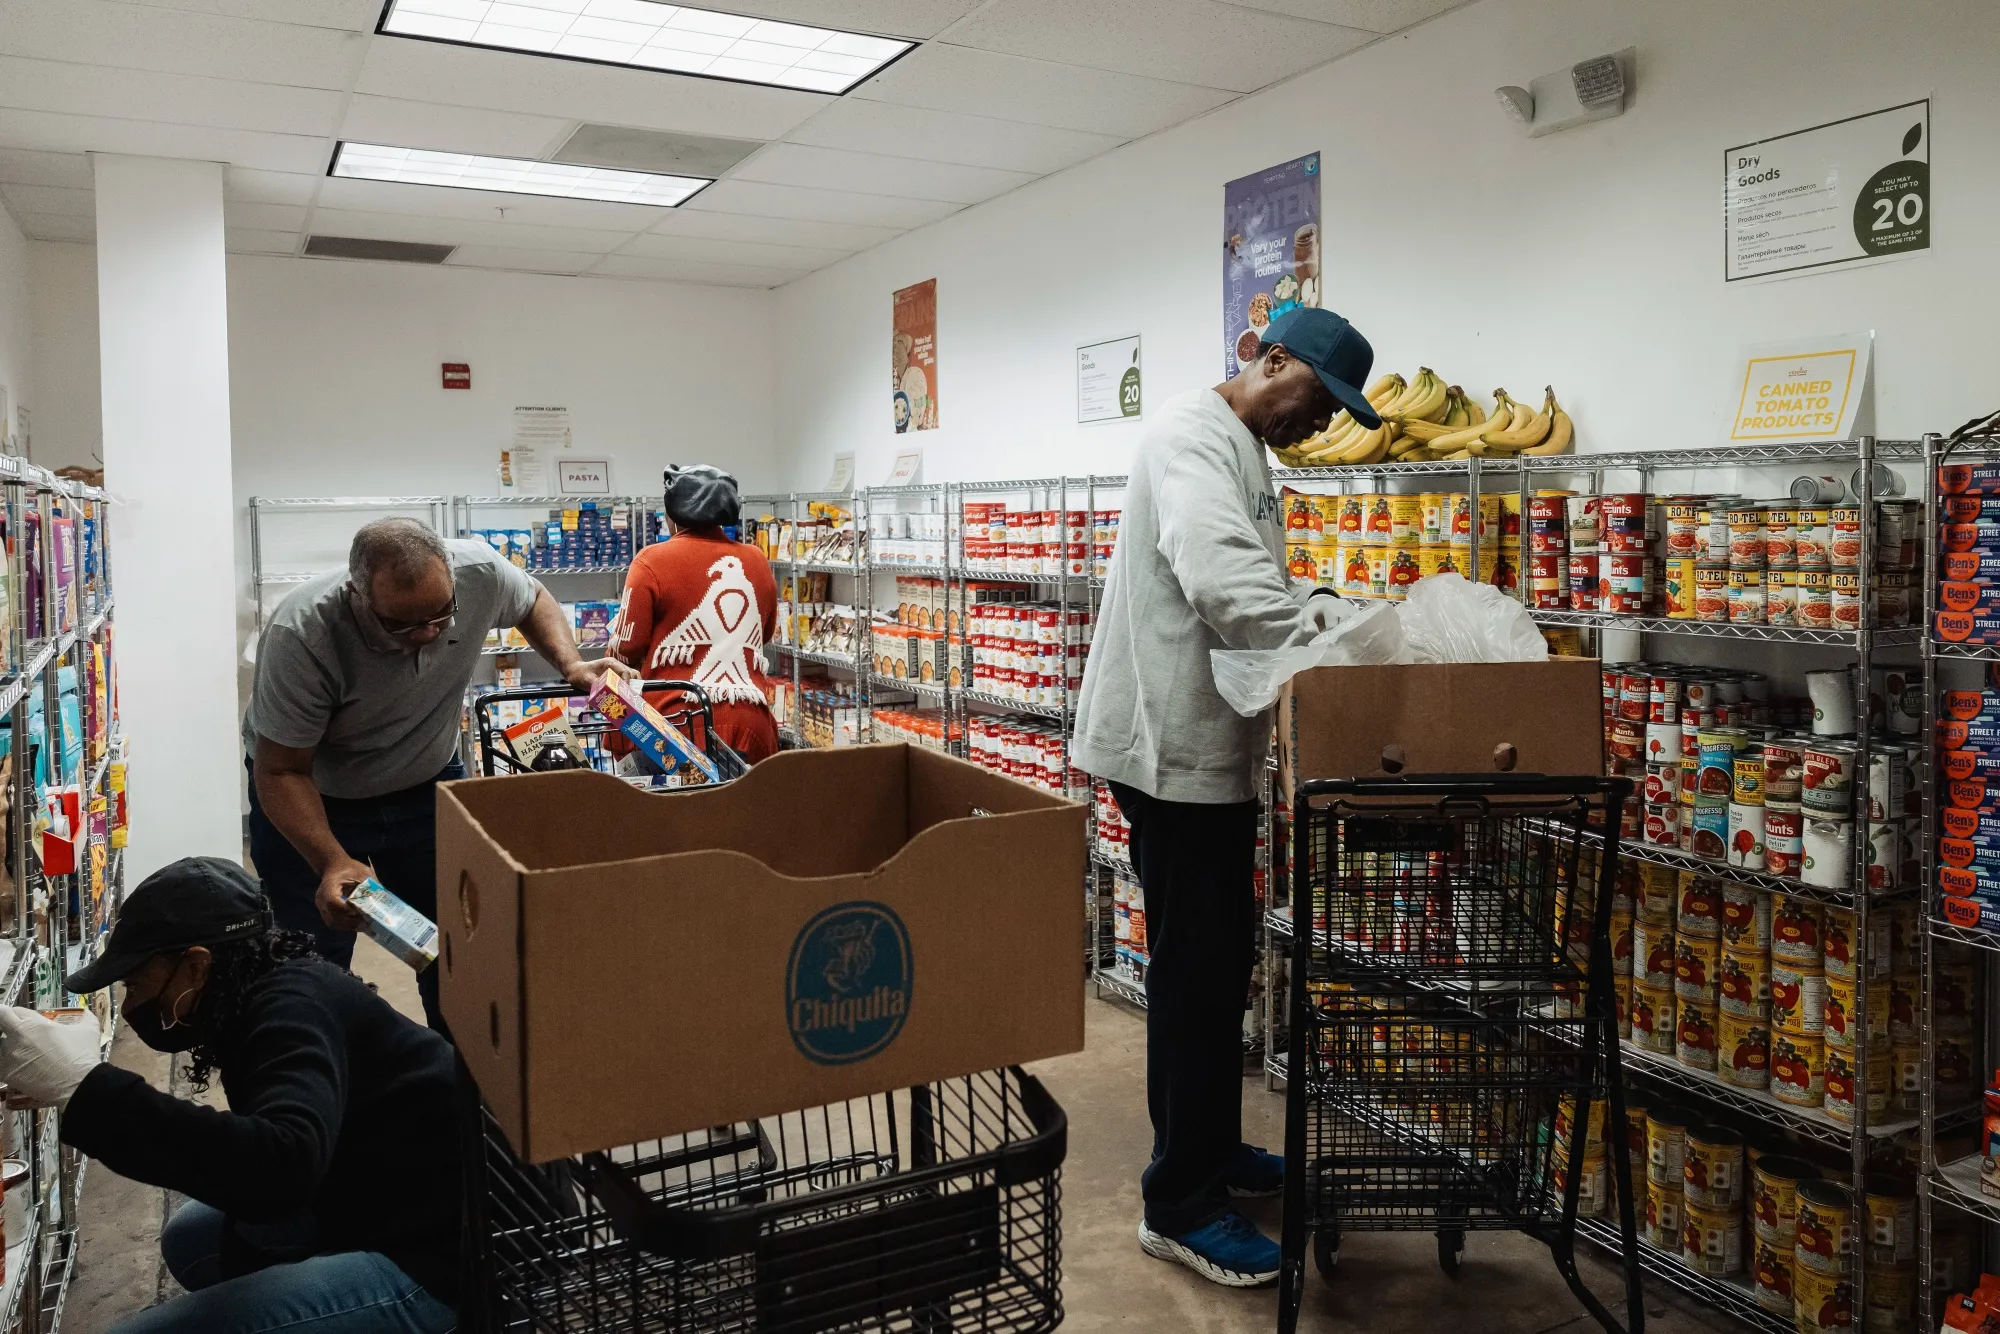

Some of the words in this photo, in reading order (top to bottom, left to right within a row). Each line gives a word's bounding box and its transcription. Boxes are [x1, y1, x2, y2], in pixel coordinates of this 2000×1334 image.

[1286, 160, 1305, 172] HEARTY
[1738, 155, 1761, 170] Dry
[1263, 173, 1286, 185] TEMPTING
[1738, 168, 1781, 188] Goods
[1897, 175, 1911, 183] MAY
[1777, 183, 1817, 197] perecederos
[1874, 185, 1898, 194] SELECT
[1738, 214, 1764, 224] Produtos
[1765, 210, 1782, 218] secos
[1872, 193, 1923, 231] 20
[1876, 233, 1901, 242] MAXIMUM
[1888, 237, 1903, 245] SAME
[1250, 241, 1268, 255] Vary
[1268, 237, 1287, 252] your
[1254, 250, 1282, 269] protein
[1254, 262, 1282, 278] routine
[1081, 353, 1089, 361] Dry
[1226, 341, 1235, 384] THINK
[1081, 362, 1096, 370] Goods
[1124, 384, 1139, 404] 20
[1759, 380, 1832, 398] CANNED
[1755, 397, 1829, 414] TOMATO
[1741, 412, 1834, 430] PRODUCTS
[568, 474, 600, 482] PASTA
[1973, 469, 1997, 478] STREET
[1612, 505, 1632, 514] unt's
[1950, 500, 1977, 511] Ben's
[1947, 528, 1973, 540] Ben's
[1979, 529, 2000, 537] STREE
[1947, 557, 1975, 569] Ben's
[1981, 559, 2000, 567] STREE
[1569, 565, 1589, 574] unt's
[1947, 587, 1976, 599] Ben's
[1941, 617, 1970, 629] Ben's
[1975, 620, 2000, 629] STREET
[1950, 696, 1978, 708] Ben's
[531, 723, 544, 733] IGA
[1969, 728, 1994, 736] STREET
[111, 748, 120, 756] RN
[1701, 744, 1732, 753] PROGRESSO
[1775, 749, 1796, 759] GLEN
[1816, 755, 1836, 766] GLEN
[1944, 755, 1972, 768] Ben's
[1976, 759, 2000, 767] STREET
[1736, 763, 1761, 772] PATO
[1953, 784, 1980, 798] Ben's
[1946, 813, 1974, 827] Ben's
[1980, 818, 2000, 827] STREE
[1769, 840, 1786, 848] Petite
[1943, 843, 1971, 857] Ben's
[1976, 848, 2000, 858] STREET
[1944, 872, 1972, 887] Ben's
[1948, 902, 1975, 918] Ben's
[1981, 911, 2000, 920] STREE
[225, 918, 256, 932] DRI-FIT
[1693, 947, 1708, 956] REGA
[1740, 962, 1755, 971] REGA
[1834, 989, 1848, 999] REGA
[792, 985, 906, 1034] Chiquita
[1733, 1026, 1747, 1036] REGA
[1796, 1045, 1812, 1055] REGA
[1766, 1185, 1780, 1196] REGA
[1819, 1215, 1836, 1226] REGA
[1778, 1254, 1794, 1263] REGA
[1818, 1282, 1833, 1292] REGA
